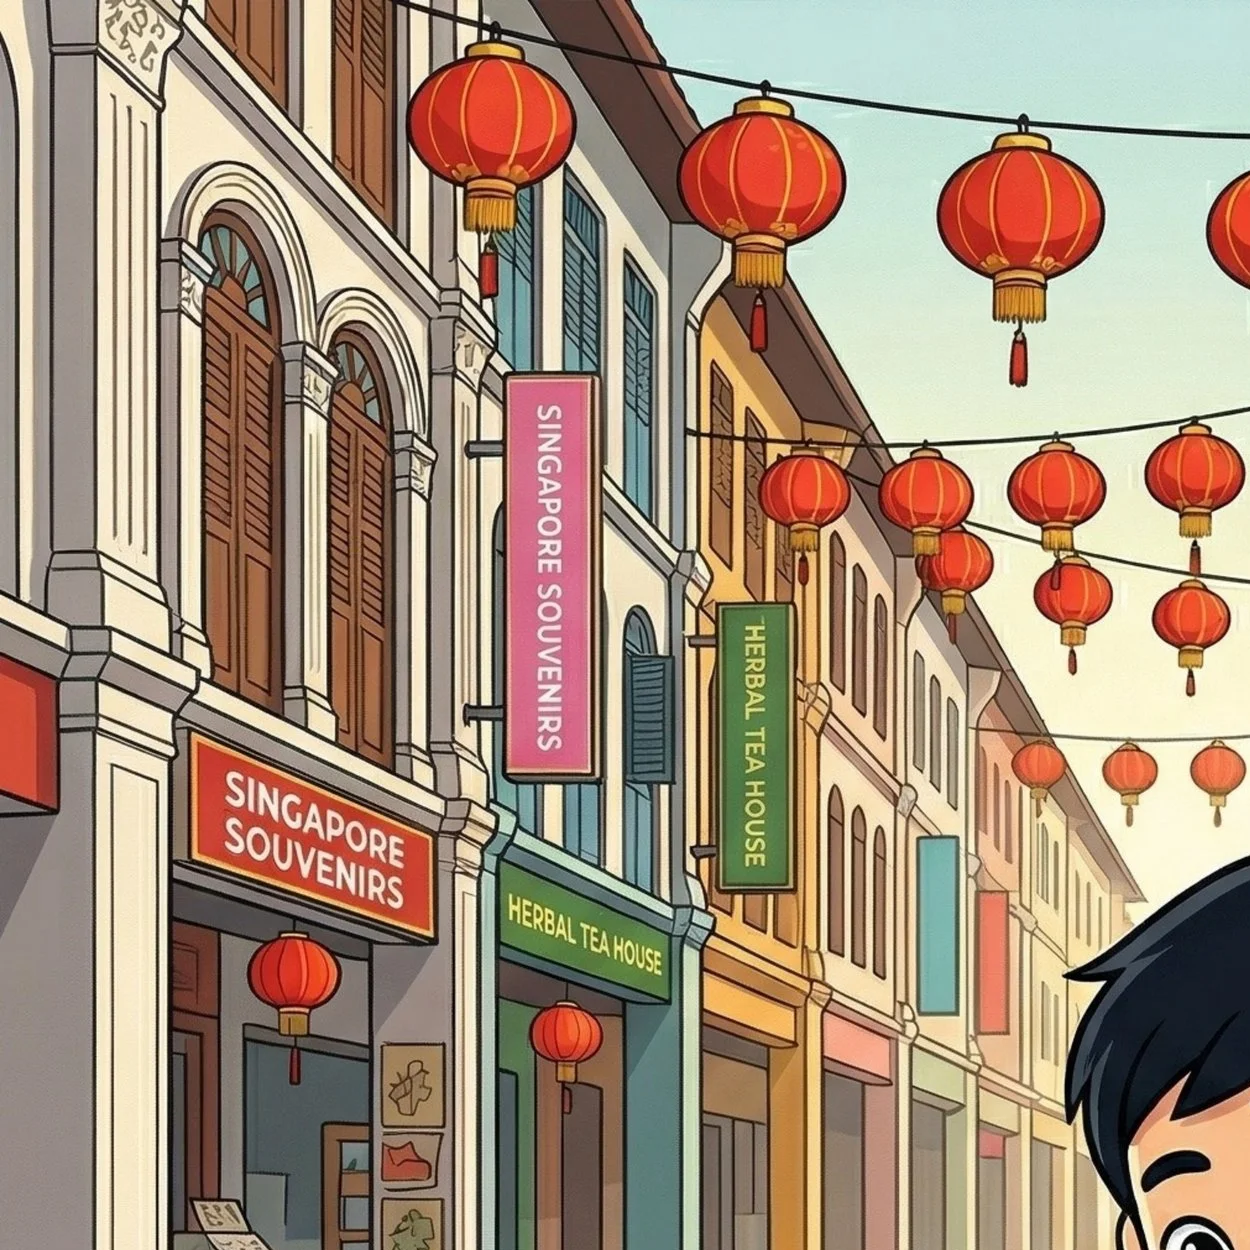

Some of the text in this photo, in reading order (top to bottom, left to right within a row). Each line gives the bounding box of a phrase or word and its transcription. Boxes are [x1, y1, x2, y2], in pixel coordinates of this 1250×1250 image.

[537, 404, 562, 752] SINGAPORE SOUVENIRS
[744, 624, 766, 867] HERBAL TEA HOUSE
[225, 771, 404, 869] SINGAPORE
[225, 817, 404, 910] SOUVENIRS
[508, 893, 663, 976] HERBAL TEA HOUSE
